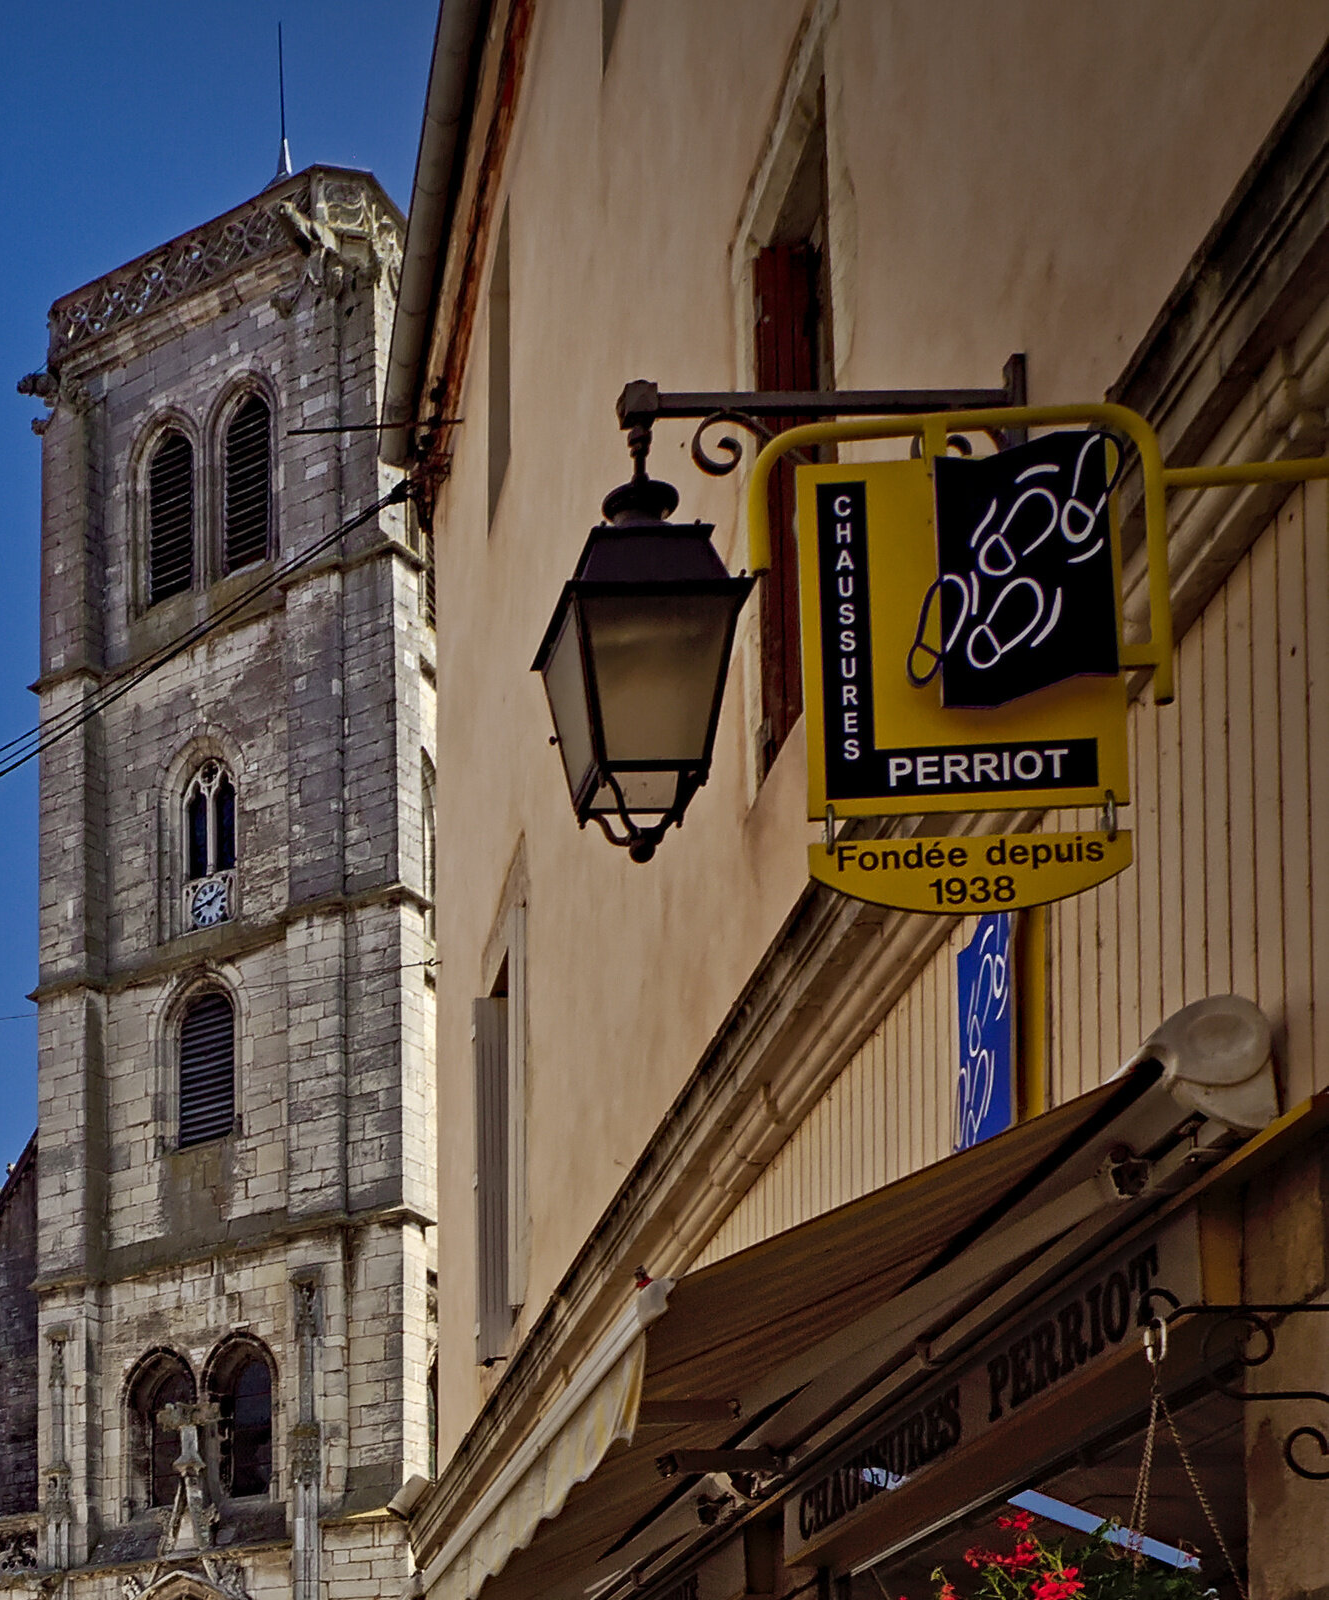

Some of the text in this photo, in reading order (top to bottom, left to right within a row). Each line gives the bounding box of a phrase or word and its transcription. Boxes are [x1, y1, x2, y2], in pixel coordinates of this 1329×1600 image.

[833, 495, 860, 761] CHAUSSURES
[888, 748, 1069, 788] PERRIOT
[837, 835, 1105, 872] Fondée depuis
[929, 875, 1016, 905] 1938
[986, 1243, 1159, 1424] PERRIOT
